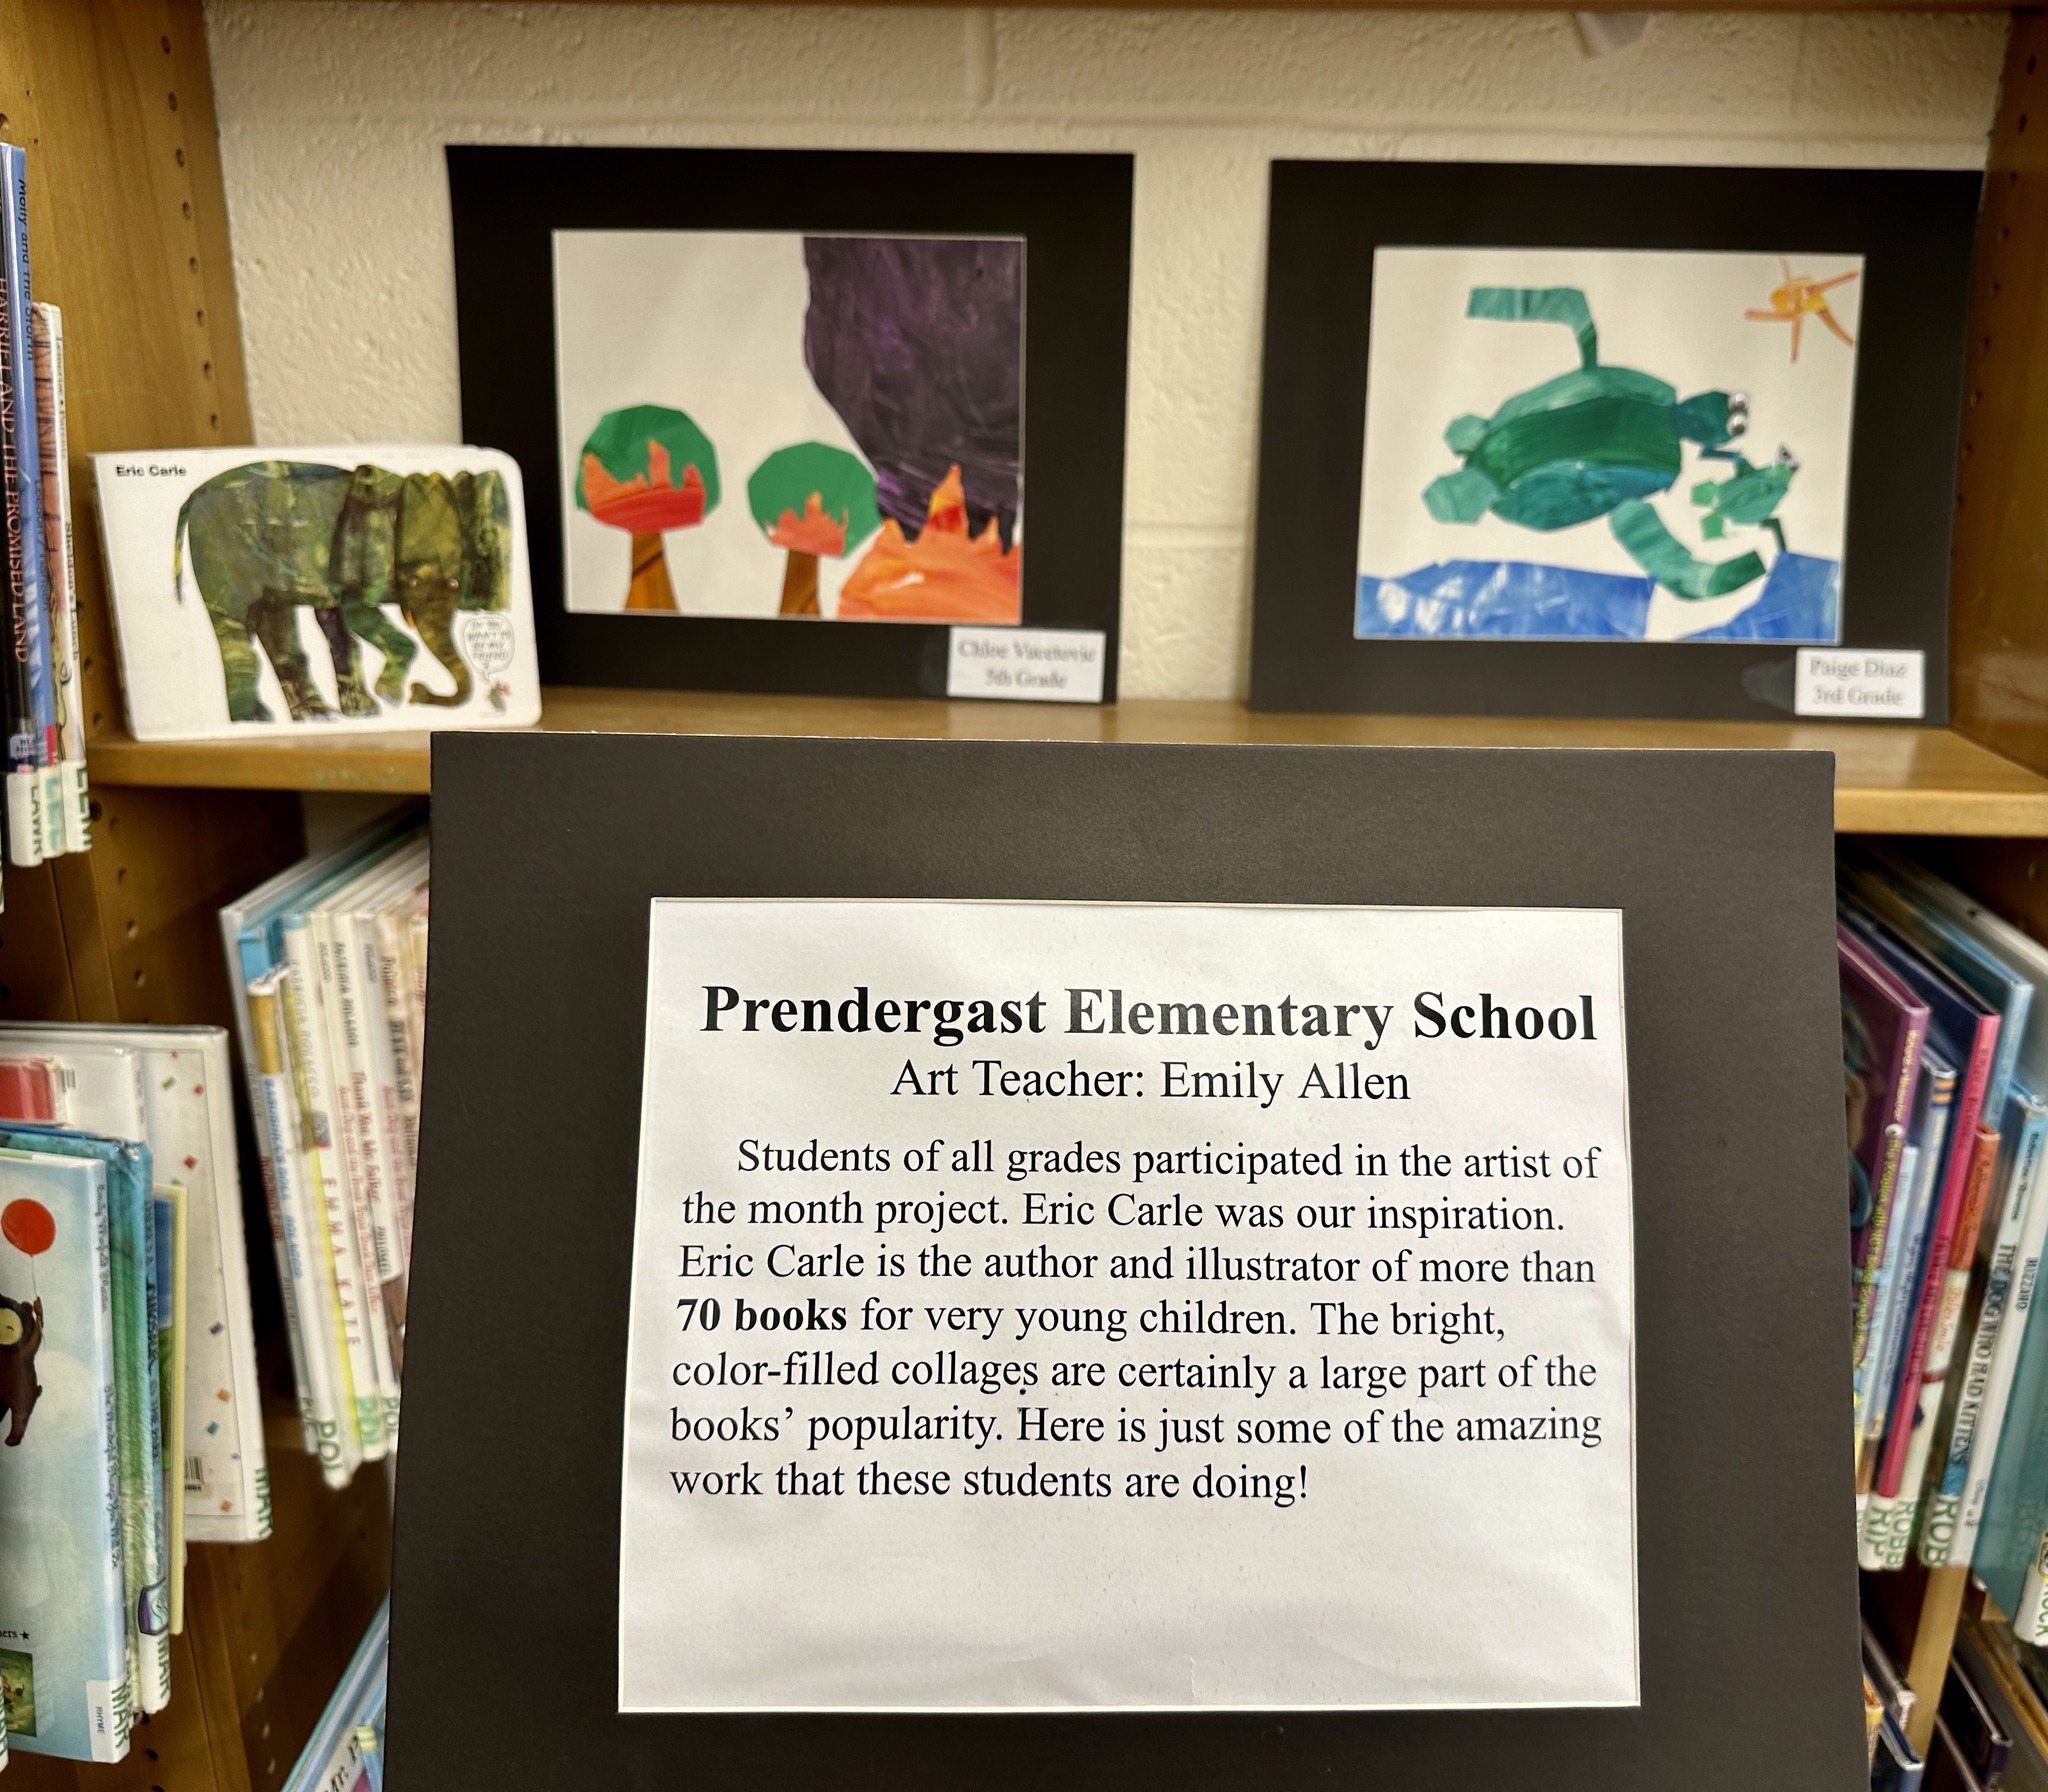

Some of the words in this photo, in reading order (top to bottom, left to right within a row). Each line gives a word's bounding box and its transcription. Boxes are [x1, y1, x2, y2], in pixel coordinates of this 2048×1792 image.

[17, 178, 29, 225] Molly
[20, 232, 31, 263] and
[1, 383, 15, 434] AND
[3, 444, 18, 484] THE
[115, 464, 145, 477] Eric
[148, 463, 187, 477] Carle
[6, 490, 24, 597] PROMISED
[12, 602, 28, 663] LAND
[70, 608, 80, 661] Lunch
[958, 639, 1009, 658] Chloe
[1015, 668, 1067, 689] Grade
[1810, 656, 1859, 681] Paige
[1865, 657, 1908, 679] Diaz
[1813, 684, 1844, 705] 3rd
[1848, 685, 1905, 706] Grade
[700, 985, 1047, 1047] Prendergast
[1064, 988, 1394, 1051] Elementary
[1414, 991, 1597, 1041] School
[890, 1058, 959, 1096] Art
[972, 1059, 1143, 1098] Teacher:
[1160, 1060, 1284, 1109] Emily
[1297, 1061, 1411, 1100] Allen
[738, 1138, 891, 1172] Students
[903, 1139, 945, 1172] of
[951, 1139, 994, 1172] all
[1006, 1140, 1121, 1182] grades
[1132, 1141, 1343, 1185] participated
[1355, 1143, 1389, 1176] in
[1399, 1143, 1452, 1177] the
[1464, 1145, 1551, 1178] artist
[1563, 1146, 1602, 1179] of
[682, 1190, 736, 1224] the
[747, 1190, 864, 1224] month
[874, 1190, 1008, 1234] project.
[1022, 1191, 1095, 1226] Eric
[1107, 1193, 1203, 1227] Carle
[1214, 1204, 1284, 1228] was
[1296, 1205, 1356, 1229] our
[1367, 1195, 1564, 1239] inspiration.
[320, 1177, 348, 1257] EMMA
[334, 1278, 361, 1347] KATE
[678, 1243, 754, 1278] Eric
[767, 1243, 865, 1278] Carle
[877, 1243, 905, 1277] is
[917, 1243, 972, 1277] the
[984, 1244, 1099, 1278] author
[1110, 1245, 1174, 1280] and
[1186, 1245, 1361, 1282] illustrator
[1372, 1248, 1413, 1282] of
[1419, 1259, 1509, 1283] more
[1521, 1249, 1596, 1283] than
[1995, 1244, 2017, 1273] THE
[676, 1297, 721, 1332] 70
[735, 1298, 847, 1331] books
[860, 1296, 914, 1331] for
[924, 1307, 1005, 1341] very
[1014, 1308, 1128, 1342] young
[1139, 1298, 1296, 1335] children.
[1310, 1301, 1379, 1336] The
[1390, 1301, 1505, 1345] bright,
[1984, 1279, 2010, 1317] DOG
[1974, 1319, 2000, 1360] WHO
[672, 1350, 880, 1386] color-filled
[891, 1350, 1039, 1391] collages
[1051, 1362, 1106, 1387] are
[1118, 1353, 1276, 1399] certainly
[1288, 1365, 1308, 1389] a
[1320, 1355, 1407, 1399] large
[1418, 1359, 1486, 1398] part
[1498, 1354, 1538, 1388] of
[1545, 1354, 1597, 1387] the
[1964, 1361, 1990, 1399] HAD
[670, 1406, 793, 1442] books’
[806, 1404, 1003, 1451] popularity.
[1017, 1407, 1105, 1442] Here
[1117, 1407, 1146, 1443] is
[1154, 1407, 1225, 1453] just
[1237, 1419, 1331, 1444] some
[1344, 1408, 1385, 1444] of
[1391, 1408, 1444, 1443] the
[1456, 1406, 1602, 1448] amazing
[1950, 1400, 1981, 1466] KITTENS
[669, 1461, 763, 1495] work
[775, 1461, 845, 1496] that
[856, 1460, 951, 1496] these
[963, 1461, 1112, 1498] students
[1125, 1473, 1180, 1498] are
[1192, 1463, 1307, 1508] doing!
[1864, 1506, 1893, 1557] RIP
[1884, 1500, 1917, 1566] ROBB
[1924, 1499, 1959, 1565] ROB
[95, 1706, 105, 1735] RHYME
[111, 1682, 130, 1749] MAR
